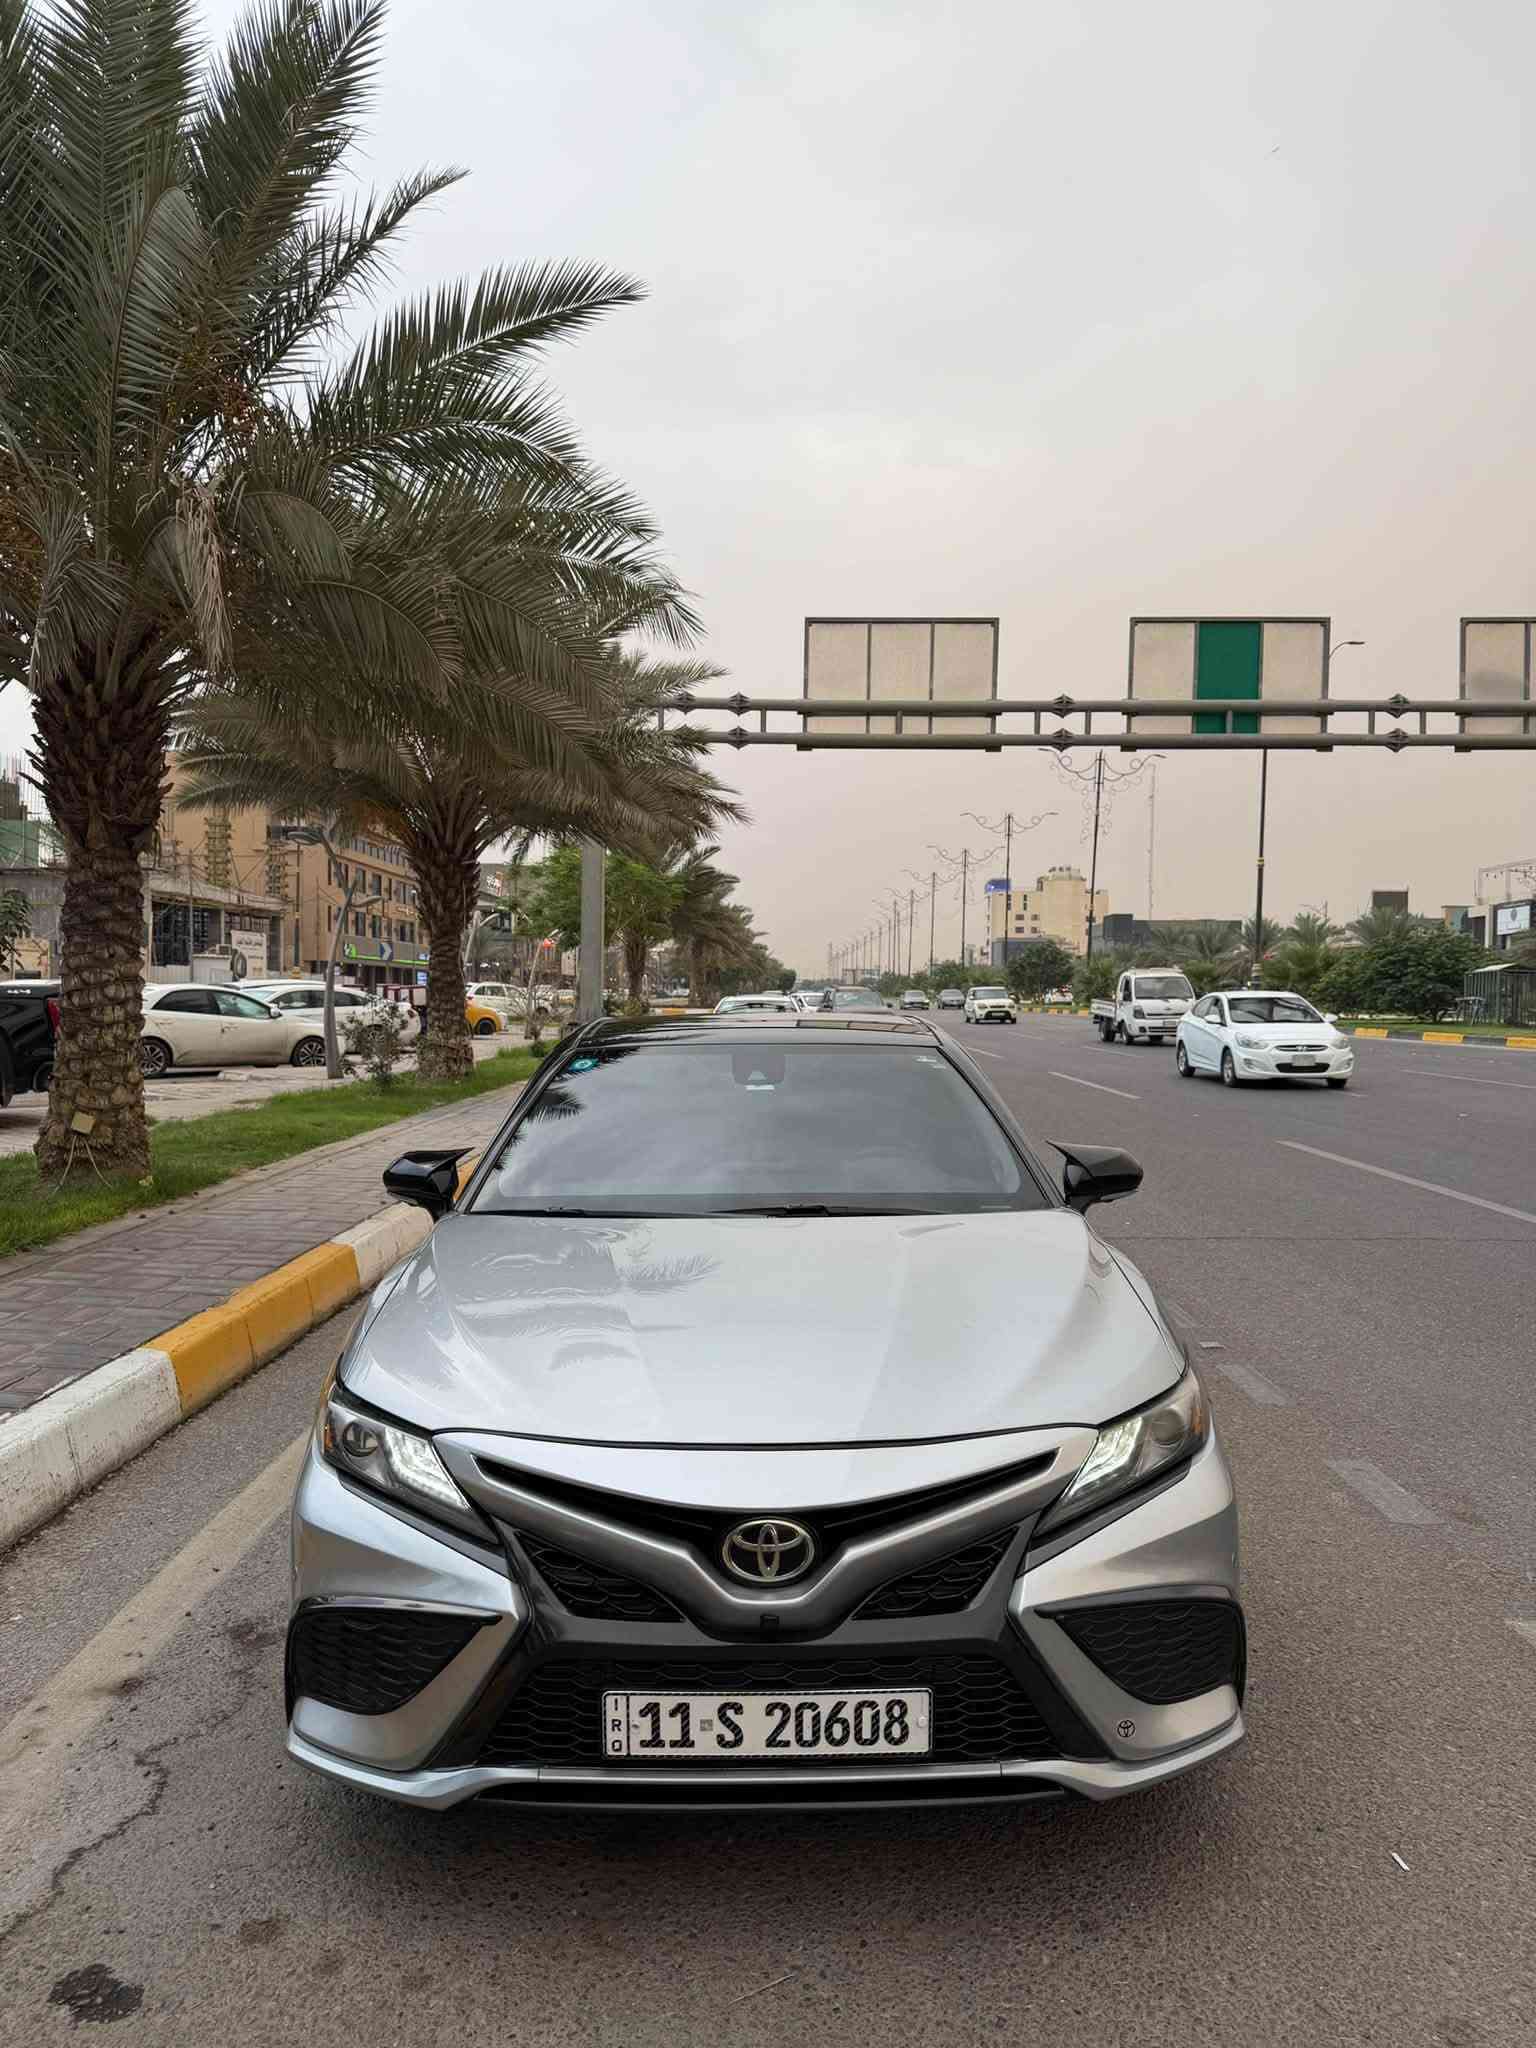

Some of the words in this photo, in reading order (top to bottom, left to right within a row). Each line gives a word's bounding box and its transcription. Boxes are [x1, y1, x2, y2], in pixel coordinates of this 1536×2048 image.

[639, 1702, 695, 1748] 11
[716, 1701, 744, 1749] S
[764, 1698, 910, 1748] 20608
